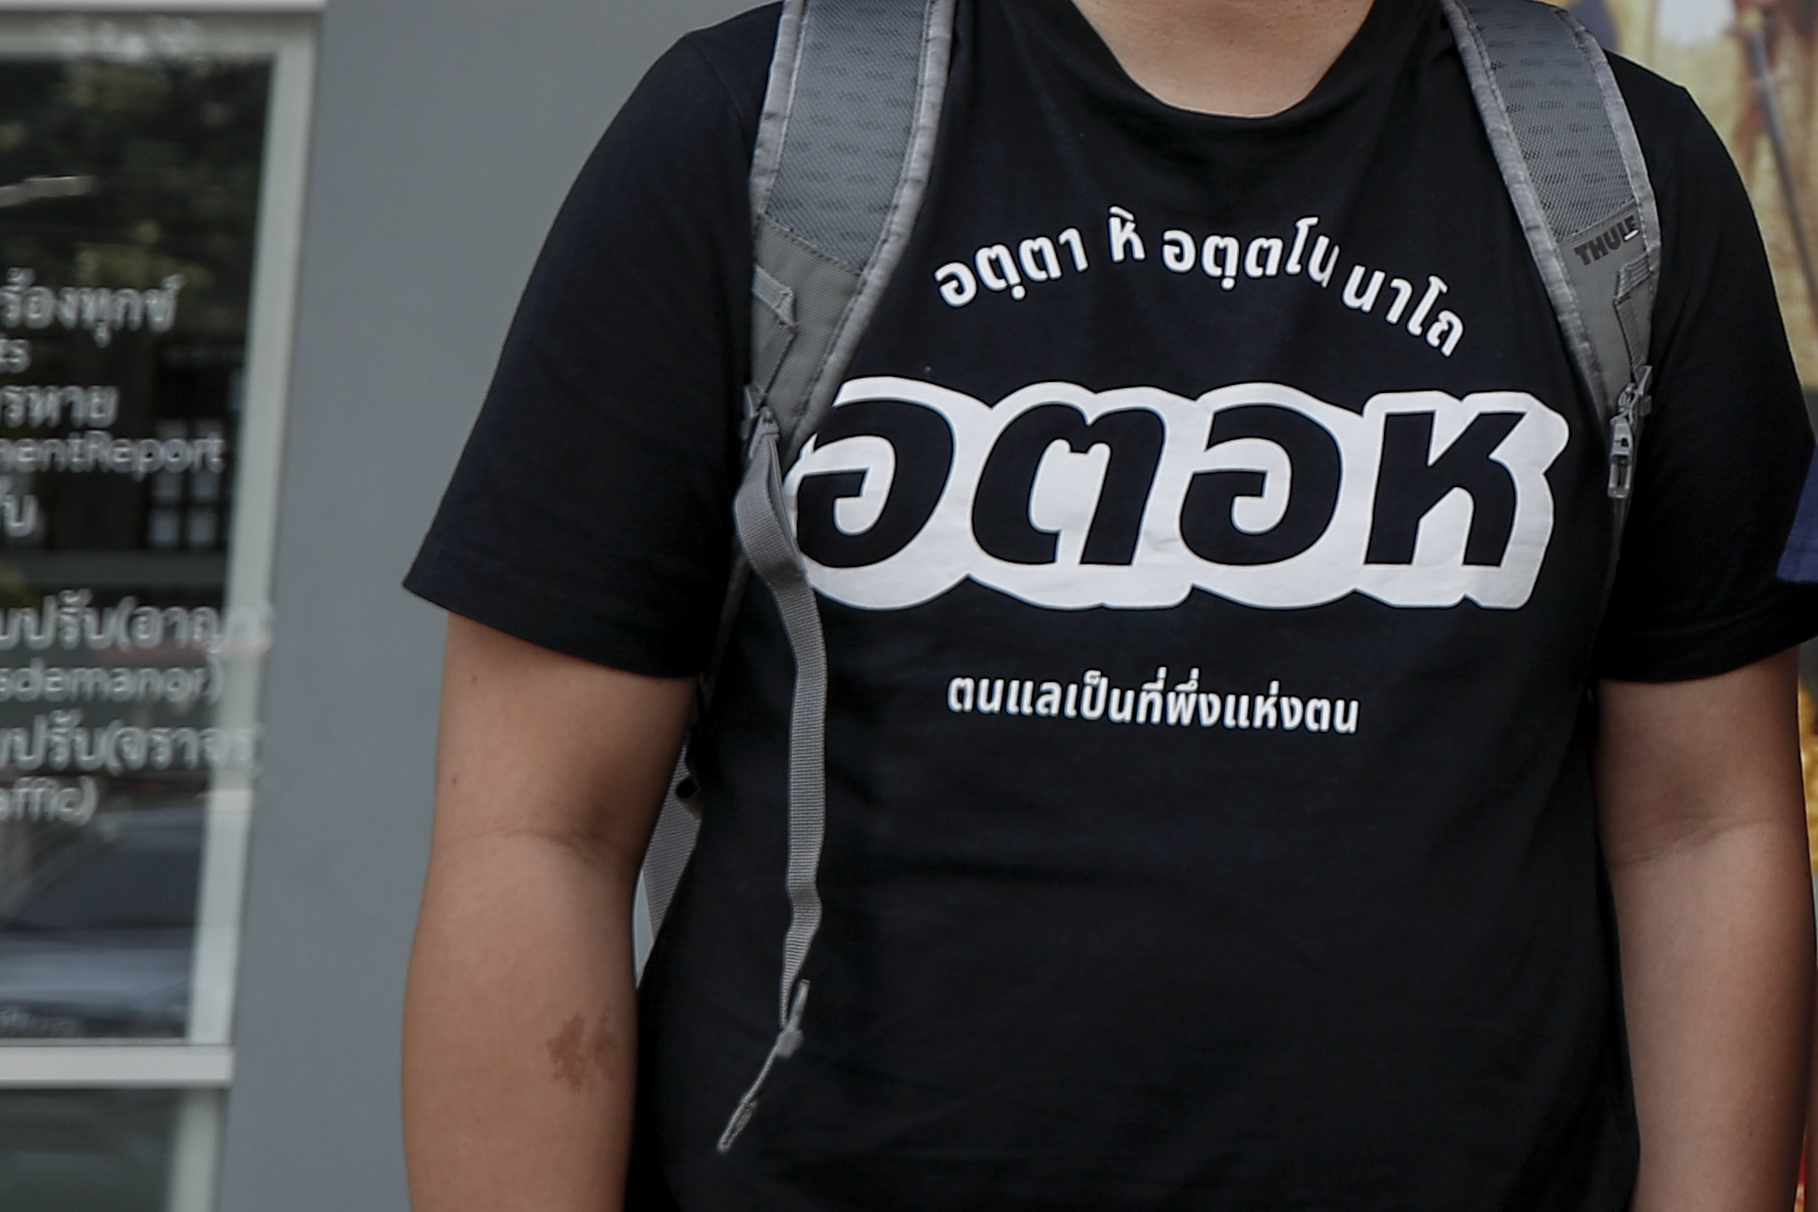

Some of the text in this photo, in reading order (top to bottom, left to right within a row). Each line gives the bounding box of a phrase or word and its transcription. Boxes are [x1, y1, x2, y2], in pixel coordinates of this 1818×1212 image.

[1574, 215, 1639, 266] THULE
[1342, 265, 1464, 357] นาโถ
[795, 393, 1530, 573] อตอห
[947, 666, 1360, 733] ตนแลเป็นที่พึ่งแห่งตน
